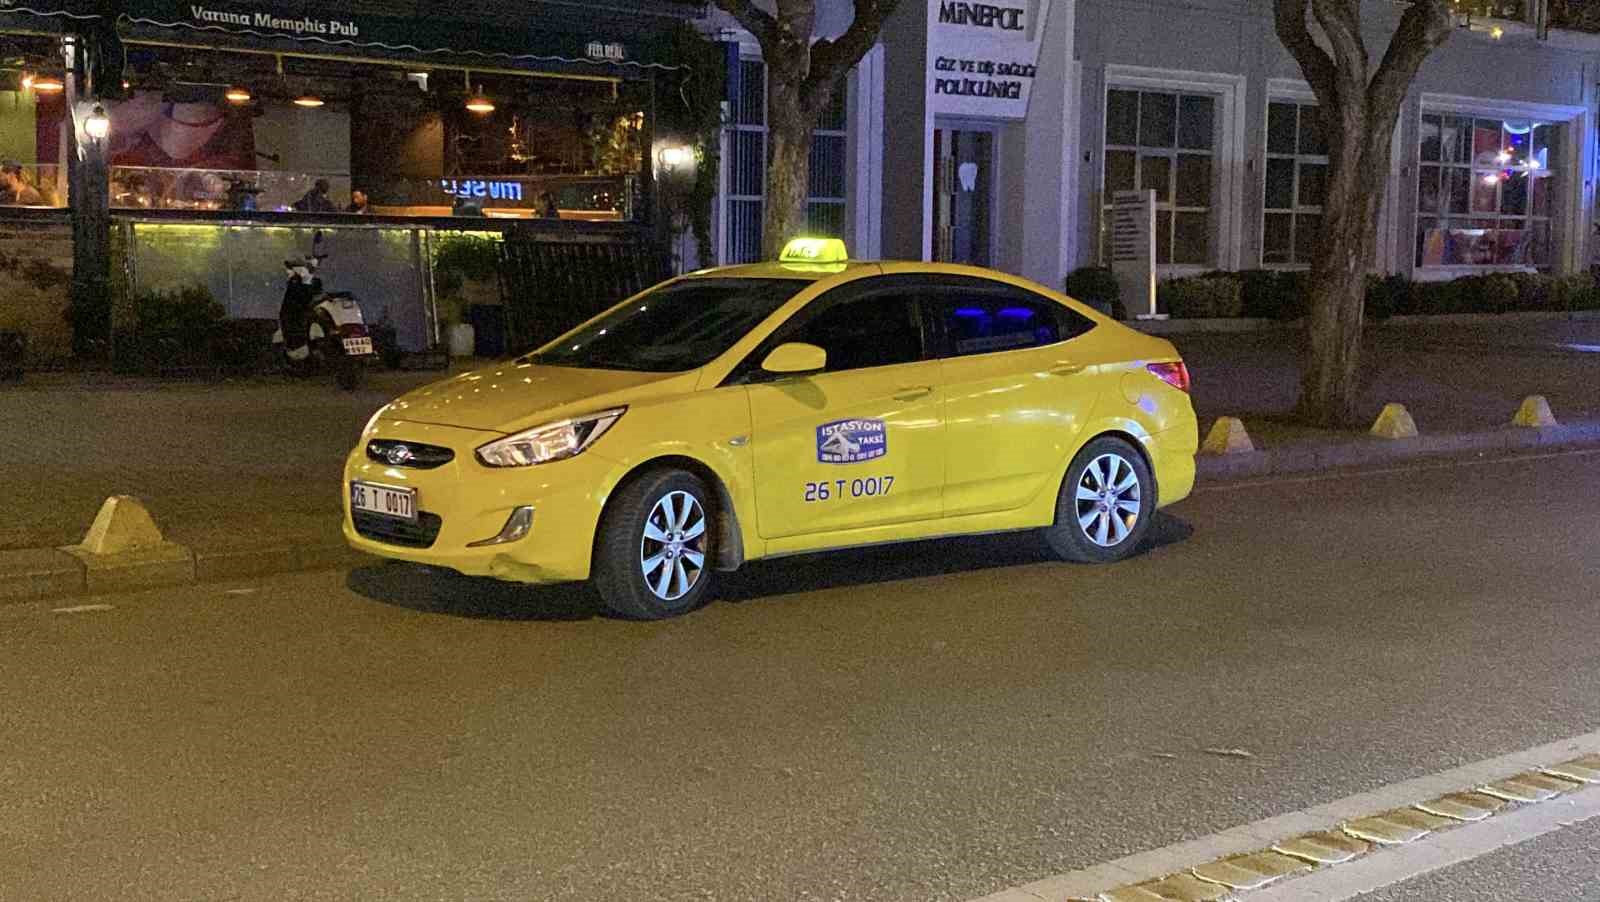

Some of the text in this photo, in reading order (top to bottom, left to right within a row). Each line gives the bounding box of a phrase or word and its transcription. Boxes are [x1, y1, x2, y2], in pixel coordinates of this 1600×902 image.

[191, 5, 359, 36] Varuna Memphis Pub
[960, 60, 975, 72] VE
[351, 487, 409, 515] 26 T 0017
[805, 476, 895, 501] 26 T 0017
